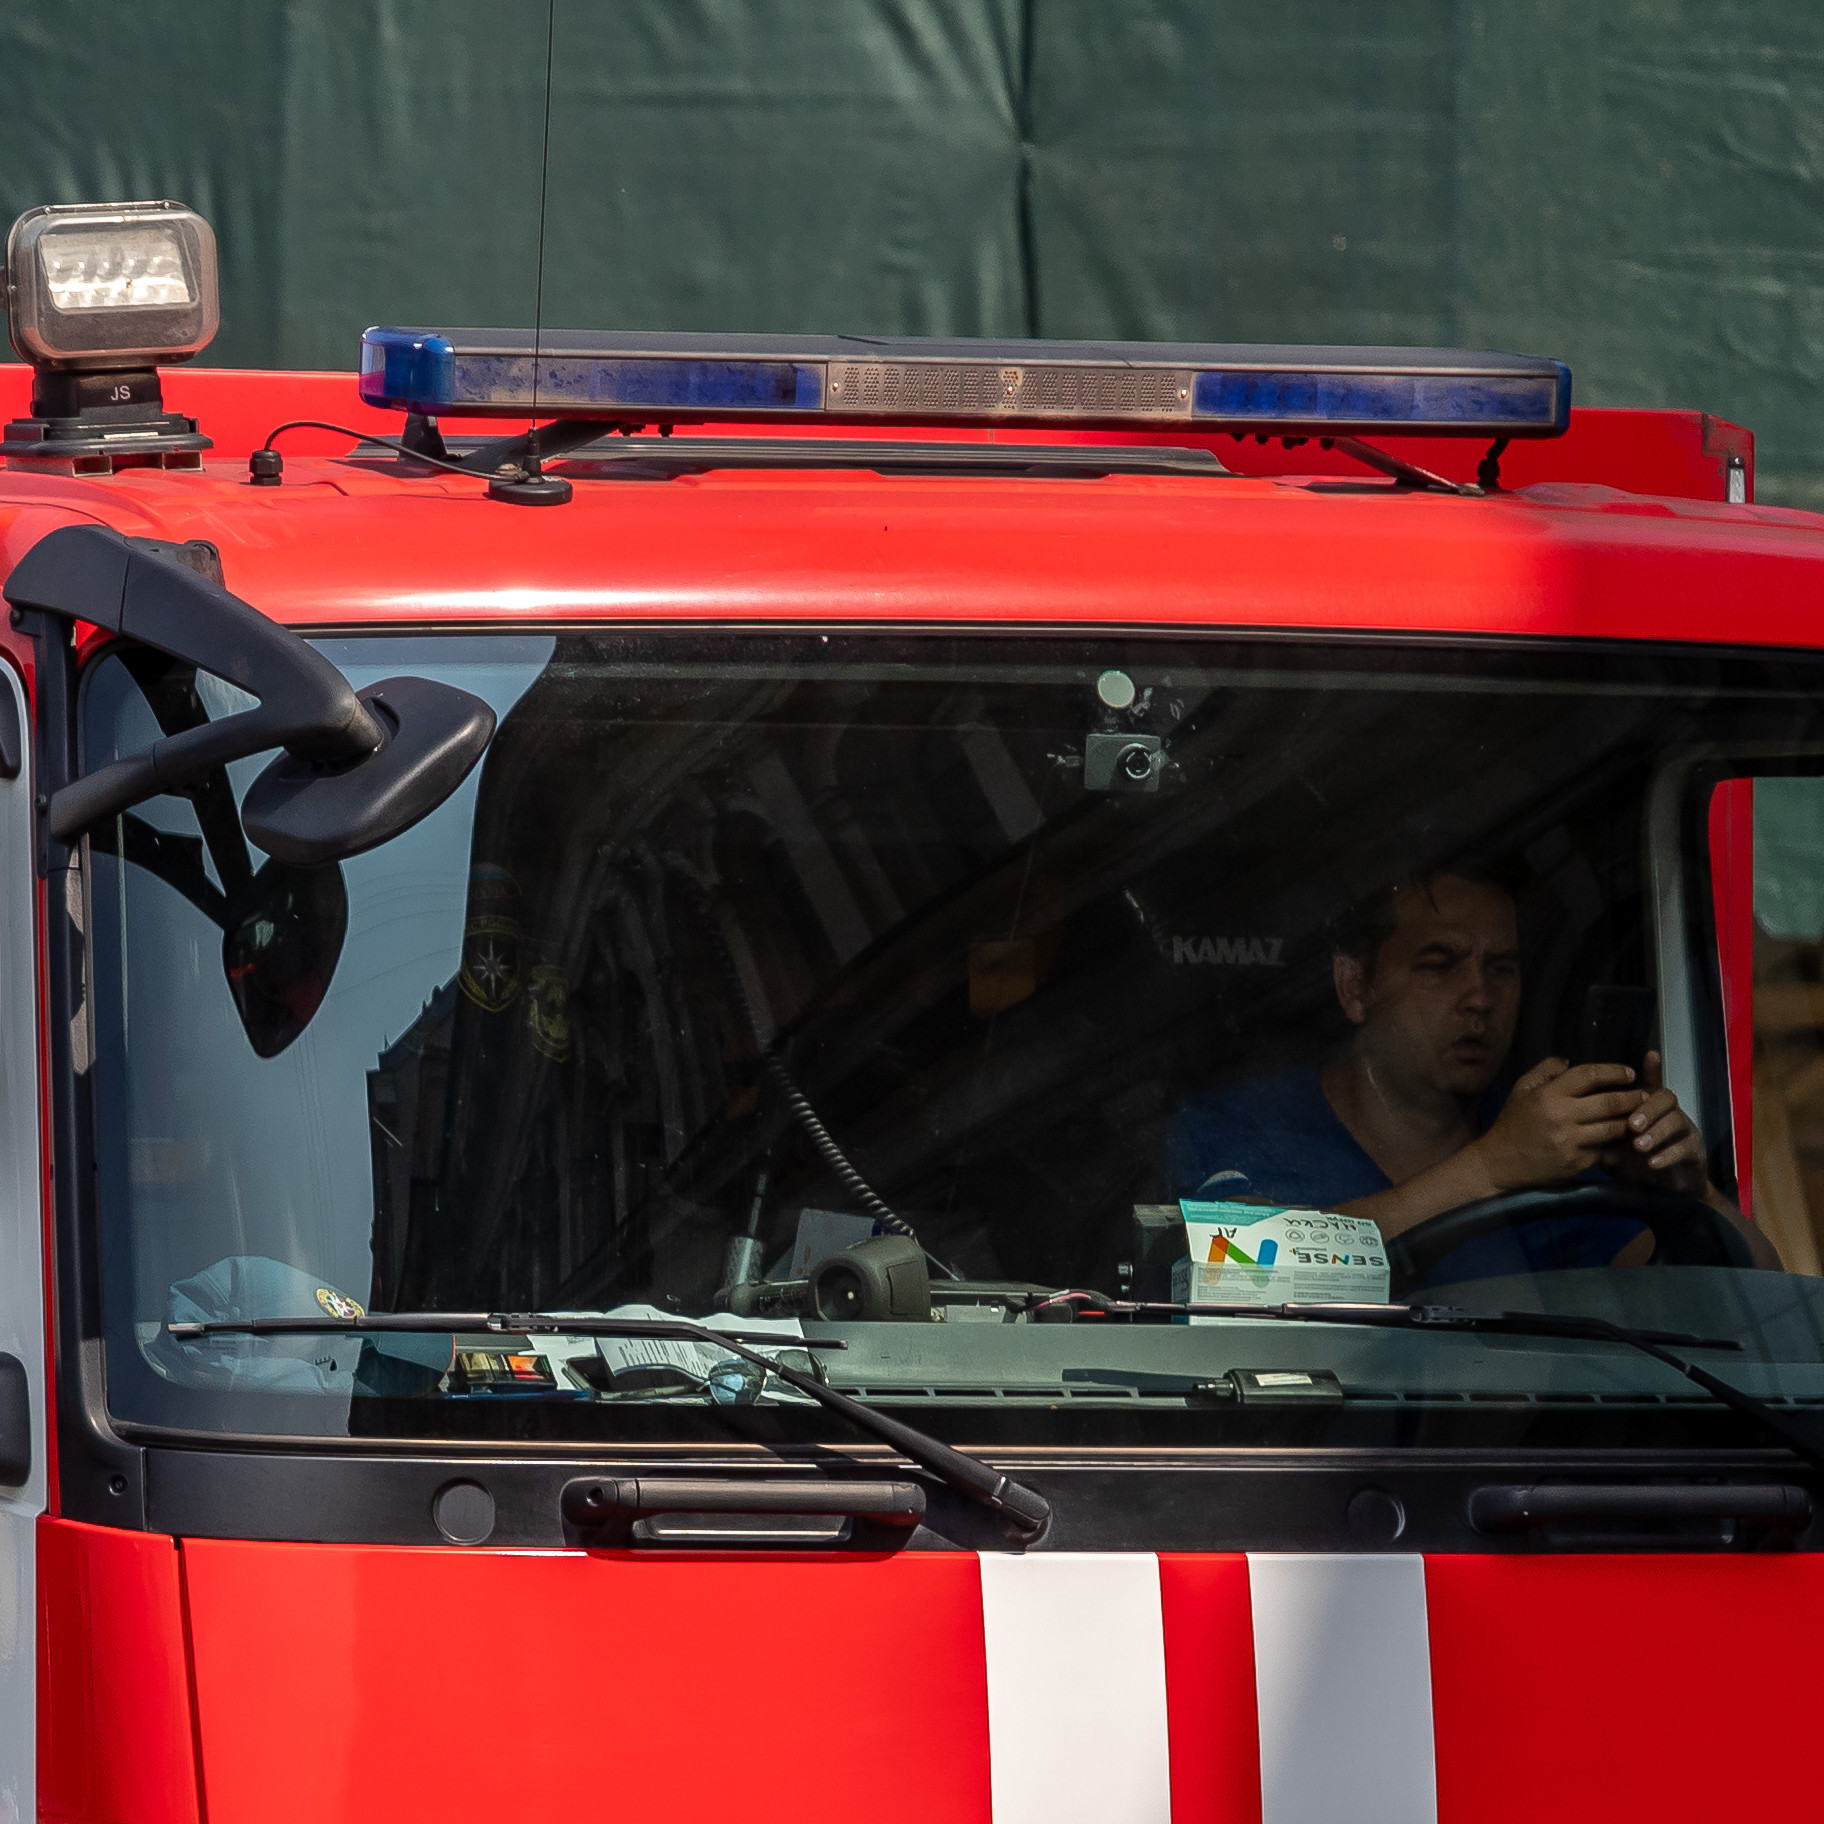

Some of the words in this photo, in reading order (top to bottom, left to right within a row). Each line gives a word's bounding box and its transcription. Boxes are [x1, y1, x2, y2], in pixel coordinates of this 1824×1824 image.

[110, 385, 131, 400] JS
[1172, 935, 1286, 966] KAMAZ
[1298, 1252, 1386, 1266] SENSE
